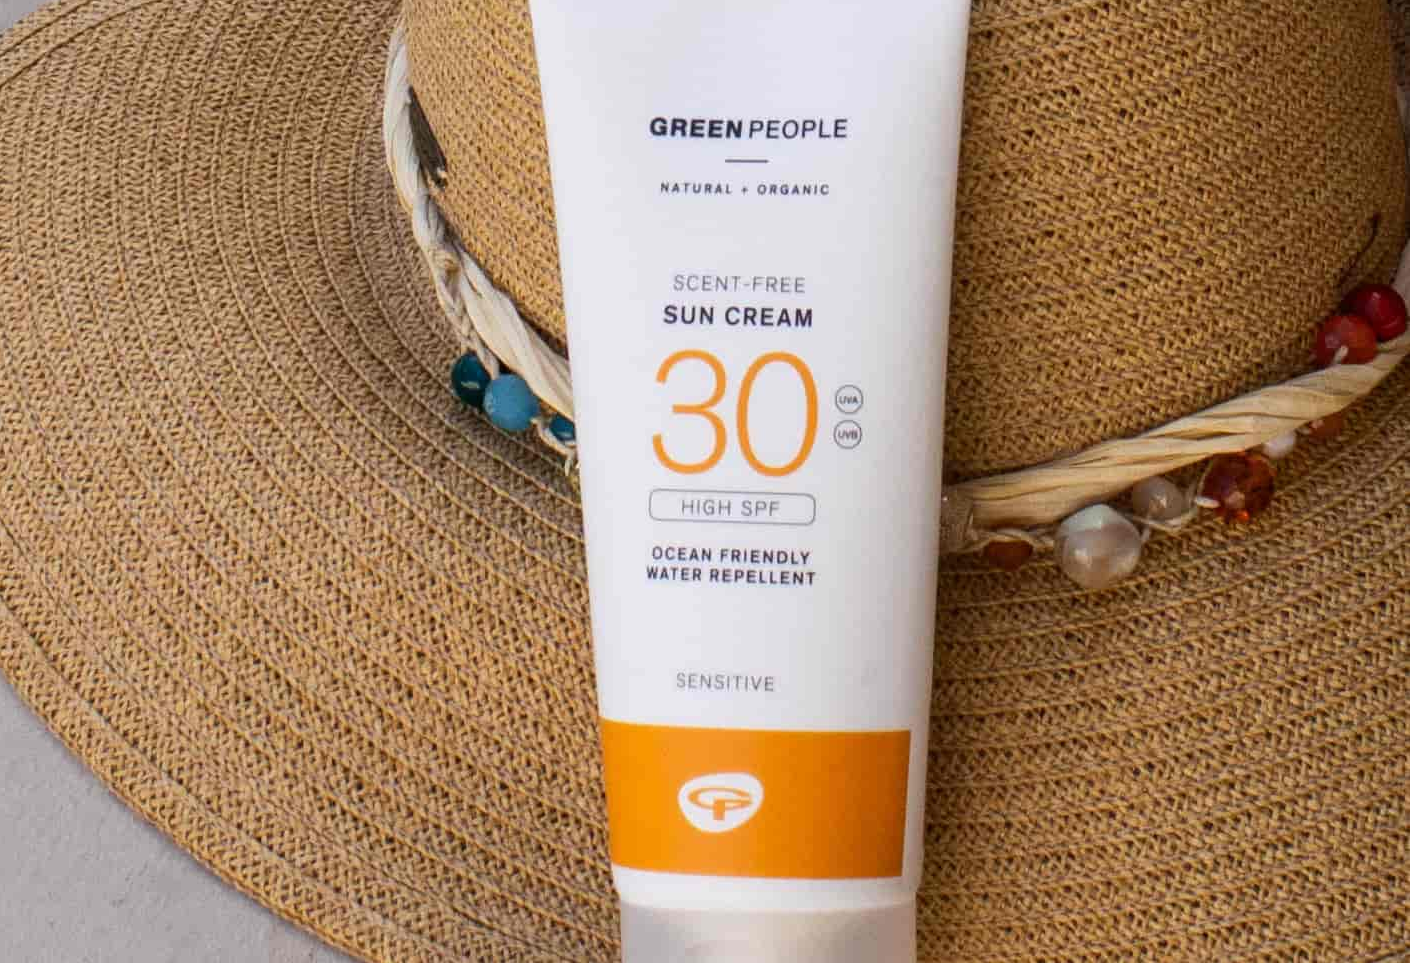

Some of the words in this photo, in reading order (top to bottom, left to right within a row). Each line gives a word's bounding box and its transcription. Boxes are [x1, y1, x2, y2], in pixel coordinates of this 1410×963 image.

[649, 117, 743, 139] GREEN
[748, 118, 848, 140] PEOPLE
[660, 182, 732, 195] NATURAL
[756, 183, 830, 196] ORGANIC
[672, 274, 806, 294] SCENT-FREE
[663, 304, 714, 325] SUN
[724, 306, 813, 328] CREAM
[652, 349, 819, 477] 30
[681, 499, 731, 516] HIGH
[741, 500, 780, 517] SPF
[652, 546, 712, 562] OCEAN
[720, 548, 810, 565] FRIENDLY
[646, 566, 702, 582] WATER
[709, 568, 816, 586] REPELLENT
[676, 672, 774, 693] SENSITIVE
